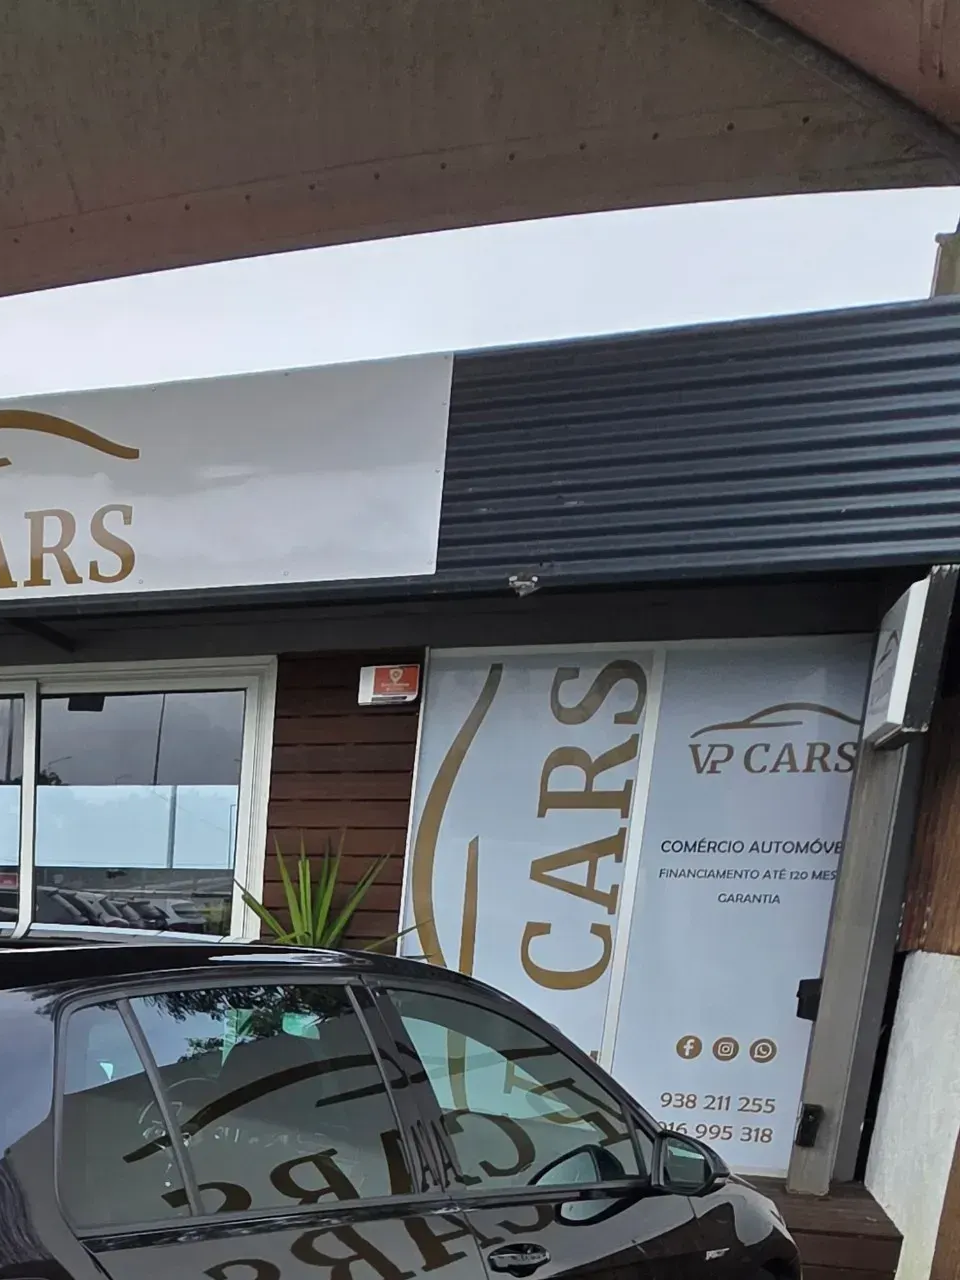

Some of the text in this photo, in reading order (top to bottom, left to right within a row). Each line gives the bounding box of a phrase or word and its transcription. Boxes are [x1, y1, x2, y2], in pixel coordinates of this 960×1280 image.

[688, 741, 858, 774] VP CARS
[520, 659, 648, 991] CARS
[660, 837, 745, 854] COMÉRCIO
[658, 867, 760, 881] FINANCIAMENTO
[762, 867, 787, 881] ATÉ
[789, 870, 809, 881] 120
[717, 892, 781, 905] GARANTIA
[660, 1092, 776, 1114] 938 211 255
[695, 1124, 733, 1140] 995
[740, 1126, 774, 1143] 318
